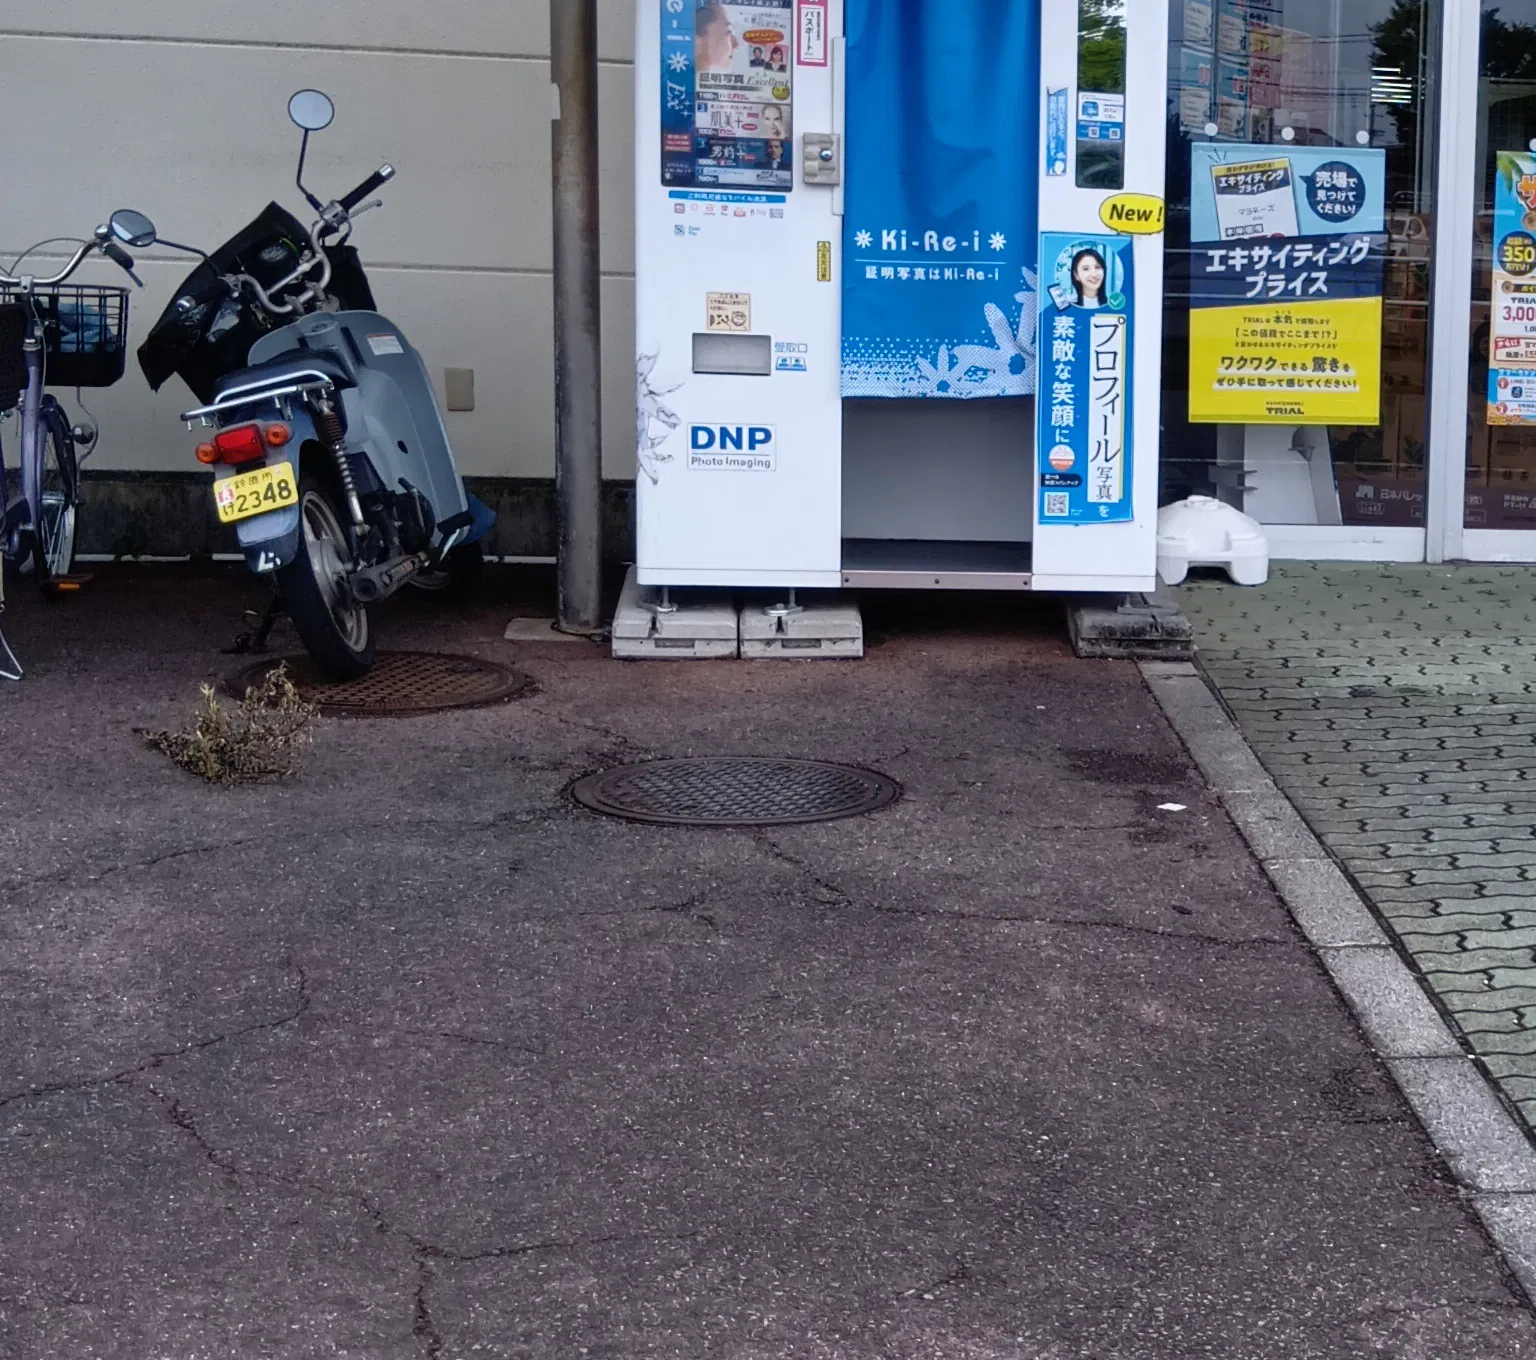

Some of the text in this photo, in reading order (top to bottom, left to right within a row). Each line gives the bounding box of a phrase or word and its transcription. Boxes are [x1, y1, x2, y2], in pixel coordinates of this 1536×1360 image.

[1219, 169, 1284, 187] エキサイティング
[1315, 170, 1358, 189] 売場で
[1239, 184, 1266, 194] プライス
[1315, 191, 1357, 202] 見つけて
[1109, 203, 1152, 222] New
[1316, 204, 1357, 215] ください!
[881, 229, 980, 252] Ki-Re-i
[1205, 236, 1371, 273] エキサイティング
[1503, 246, 1536, 263] 350
[1245, 270, 1329, 299] プライス
[774, 342, 808, 353] 受取口
[1050, 315, 1077, 444] 素敵な笑顔に
[1216, 377, 1357, 389] ぜひ手に取って感じてください!
[1089, 316, 1127, 518] プロフィール写真を
[1265, 407, 1305, 415] TRIAL
[691, 425, 772, 451] DNP
[691, 455, 771, 469] Photo Imaging
[236, 478, 293, 513] 2348
